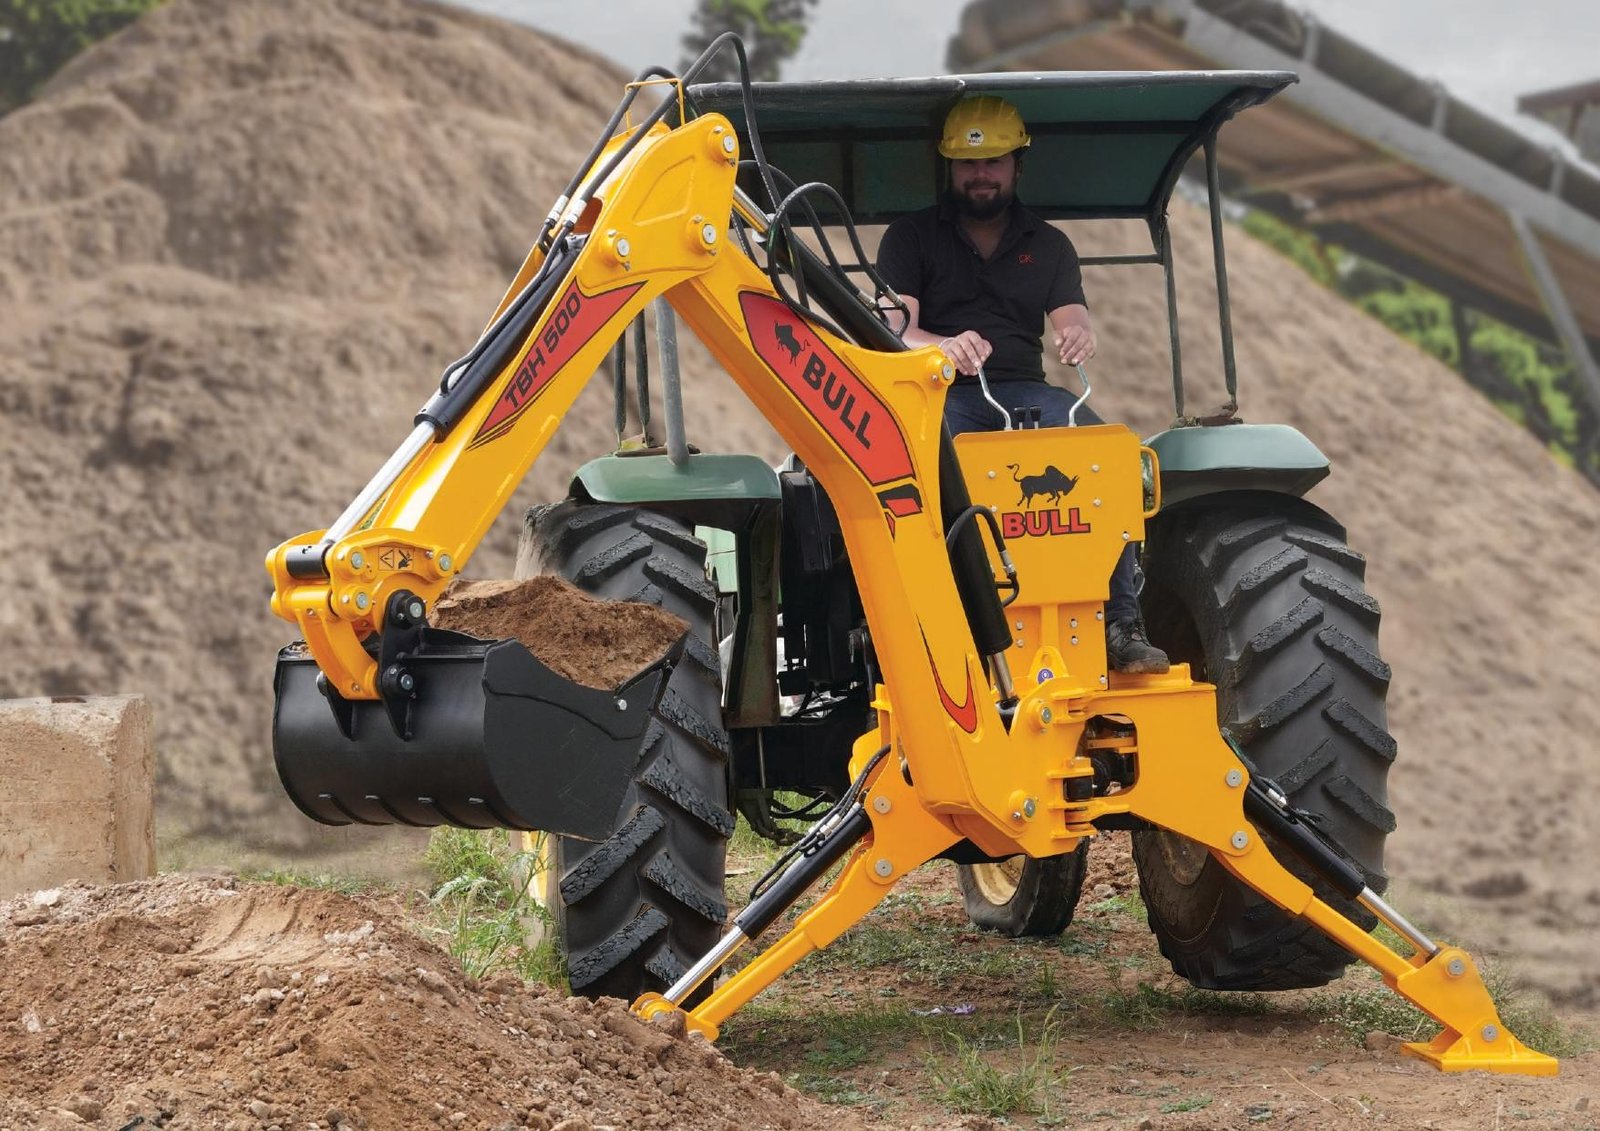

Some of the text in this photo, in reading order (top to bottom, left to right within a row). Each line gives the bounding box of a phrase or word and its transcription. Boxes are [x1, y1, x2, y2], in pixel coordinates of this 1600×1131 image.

[504, 292, 581, 408] TBH 500
[802, 351, 872, 450] BULL
[1002, 507, 1091, 539] BULL
